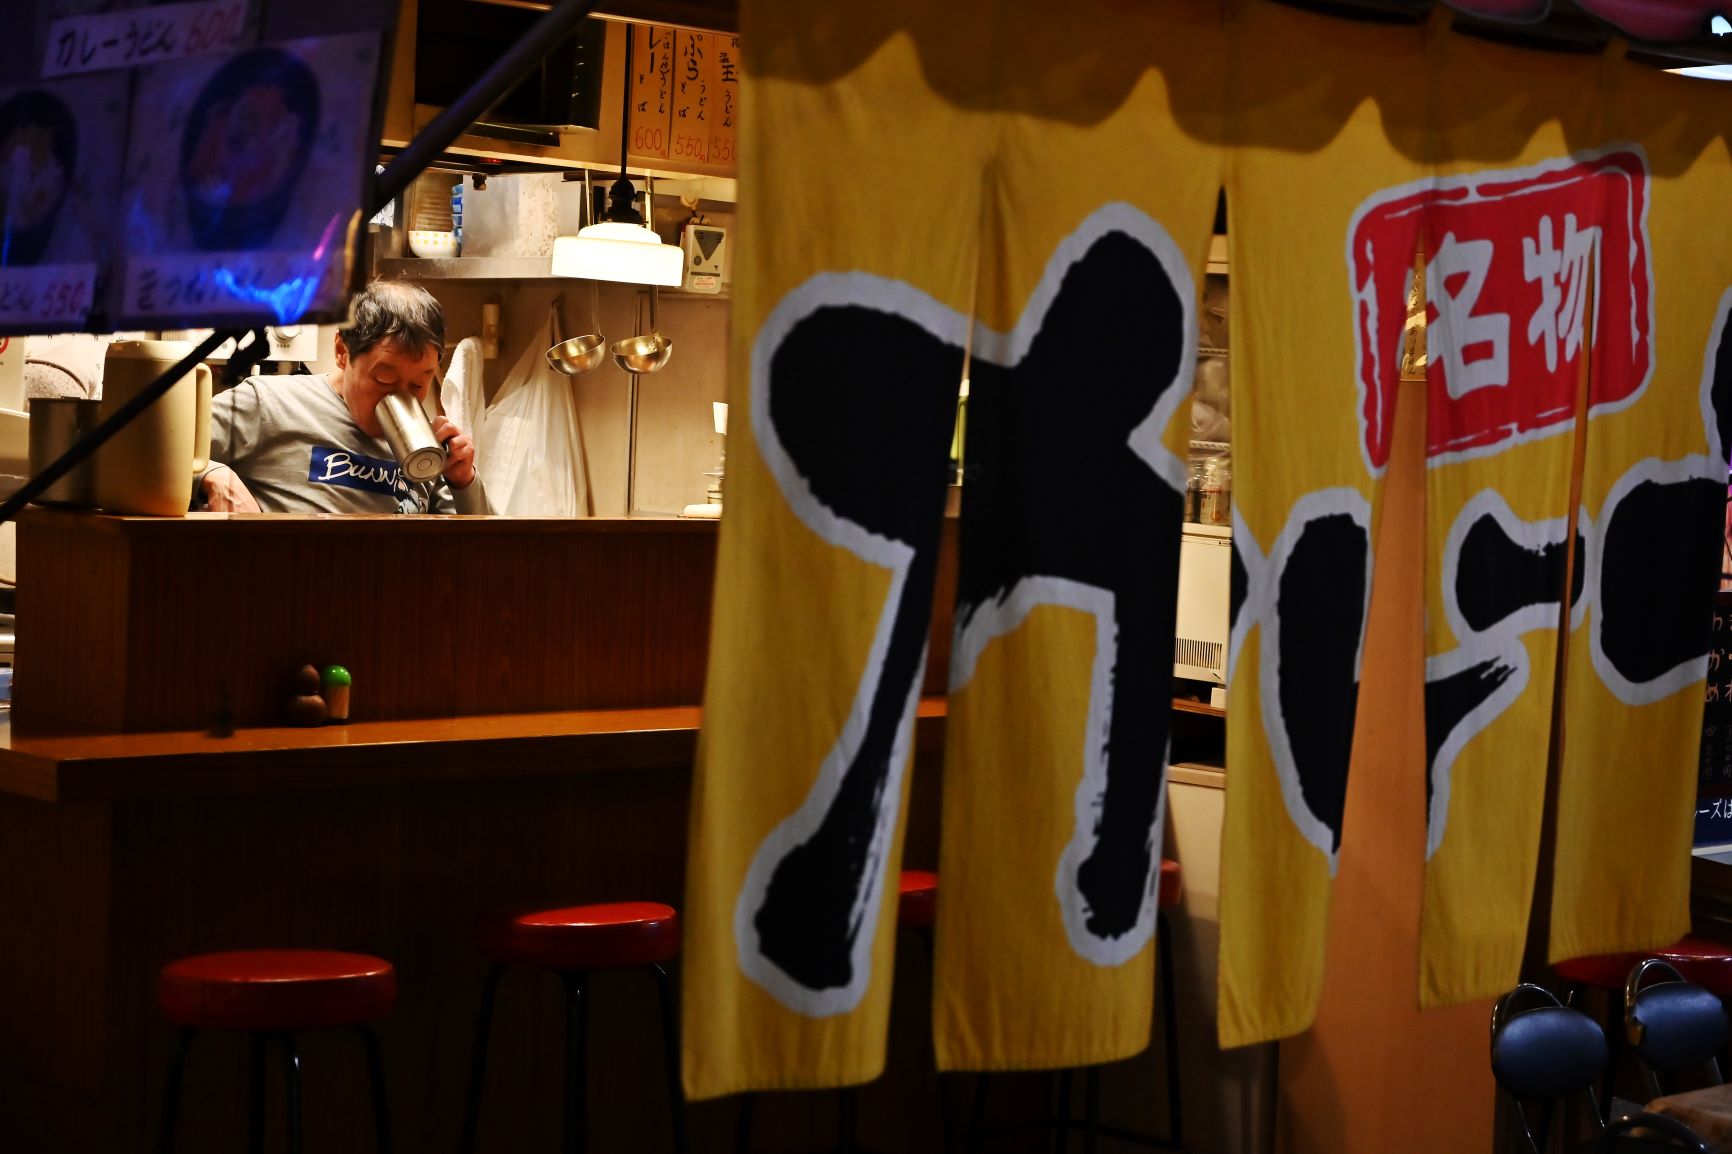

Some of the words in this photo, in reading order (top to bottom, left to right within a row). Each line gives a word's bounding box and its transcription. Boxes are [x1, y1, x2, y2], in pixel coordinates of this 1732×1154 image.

[56, 19, 175, 67] カレーうどん
[697, 80, 708, 121] うどん
[1397, 214, 1602, 400] 名物
